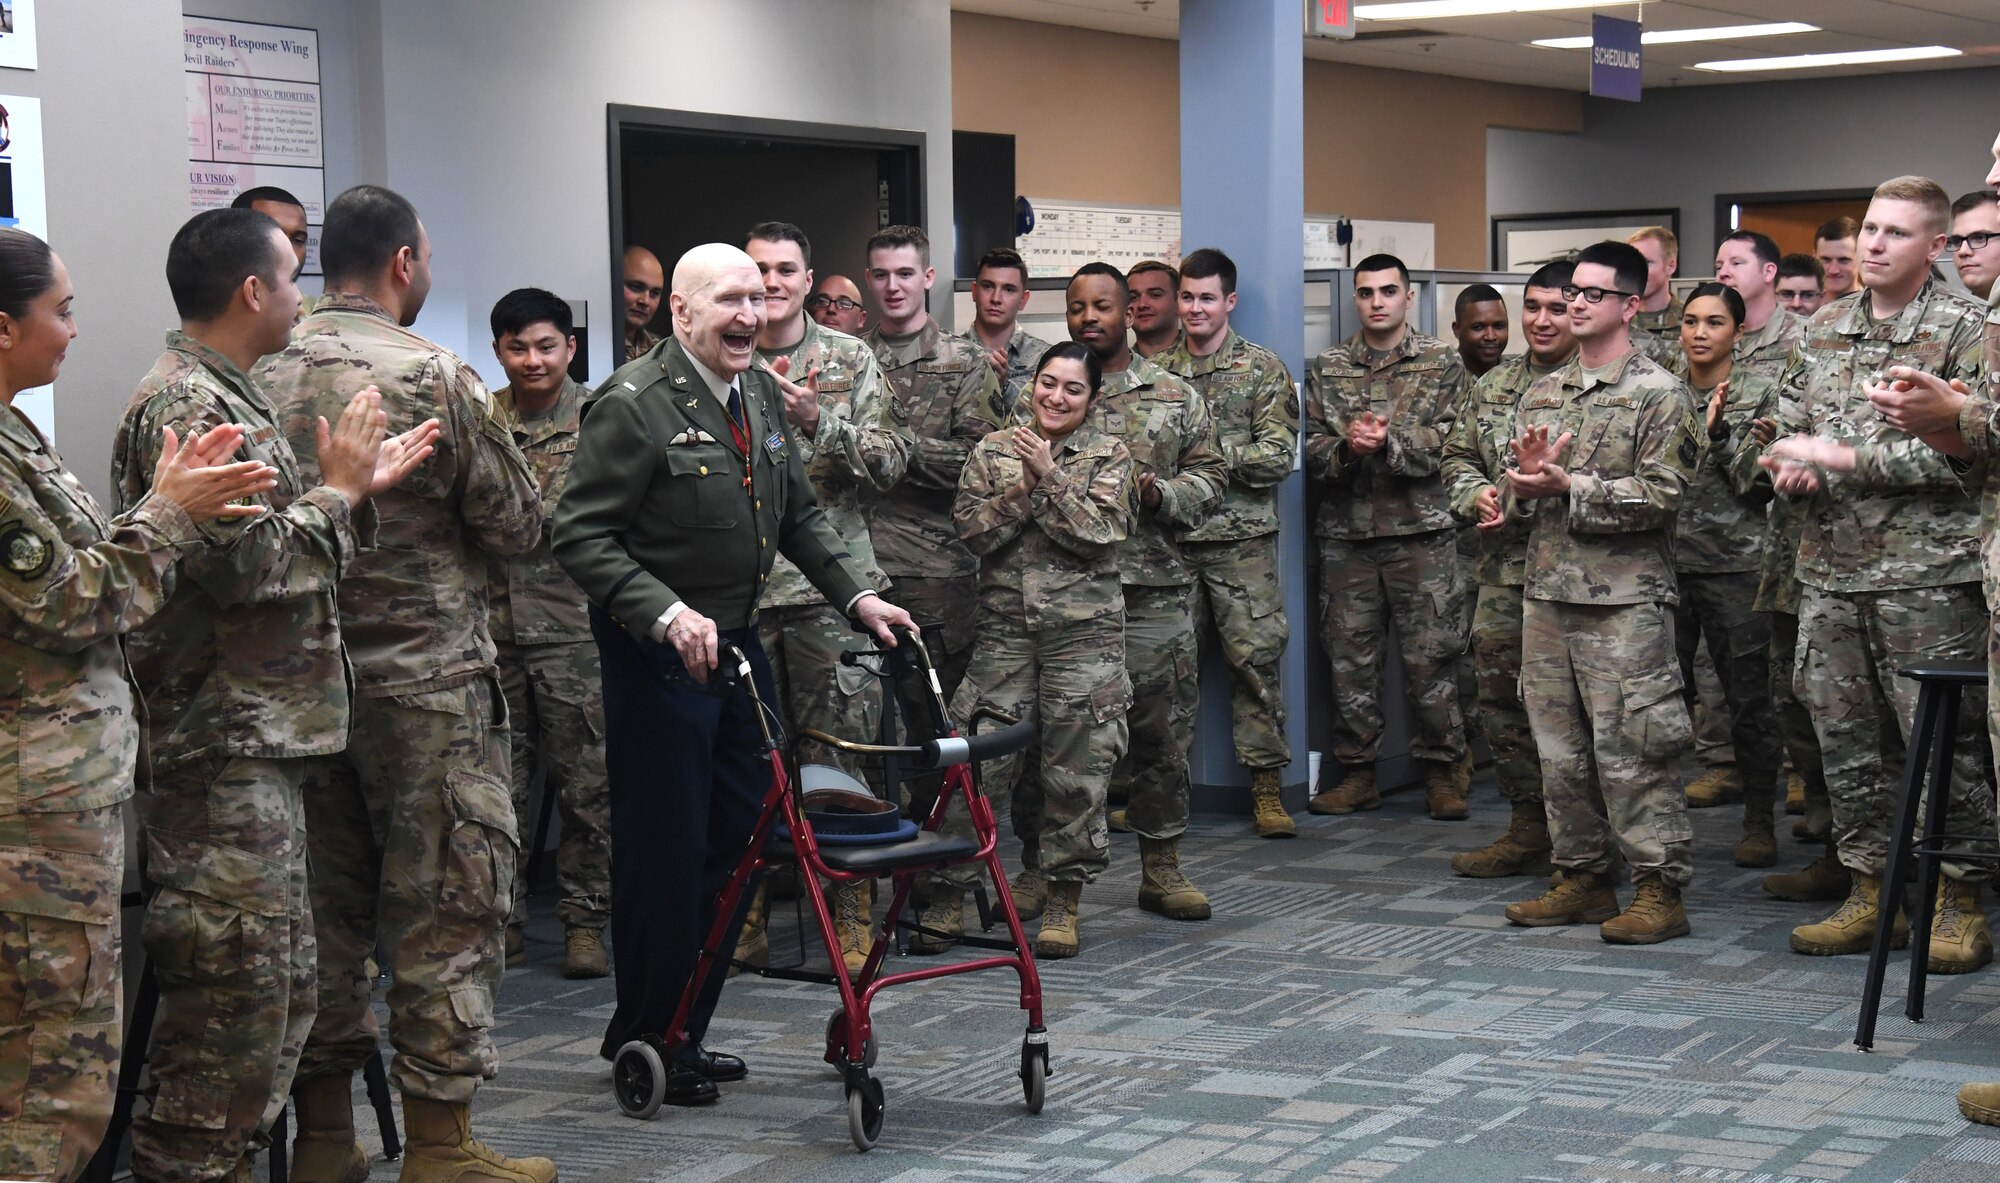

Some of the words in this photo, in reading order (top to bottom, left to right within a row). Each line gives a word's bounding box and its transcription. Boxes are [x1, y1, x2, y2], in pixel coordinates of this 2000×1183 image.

[230, 34, 278, 53] Response
[280, 40, 309, 59] Wing
[1594, 46, 1639, 70] SCHEDULING
[214, 85, 231, 96] OUR
[232, 86, 272, 98] ENDURING
[274, 90, 315, 101] PRIORITIES
[190, 173, 202, 183] UR
[204, 173, 237, 184] VISION:
[190, 187, 207, 196] lways
[1041, 213, 1059, 221] MONDAY
[1115, 216, 1132, 224] TUESDAY
[942, 363, 960, 371] FORCE
[675, 376, 687, 384] US
[552, 443, 564, 452] U.S.
[566, 441, 577, 450] AIR
[995, 444, 1020, 459] WILLIA
[1078, 451, 1088, 460] AIR
[1089, 448, 1109, 458] FORCE
